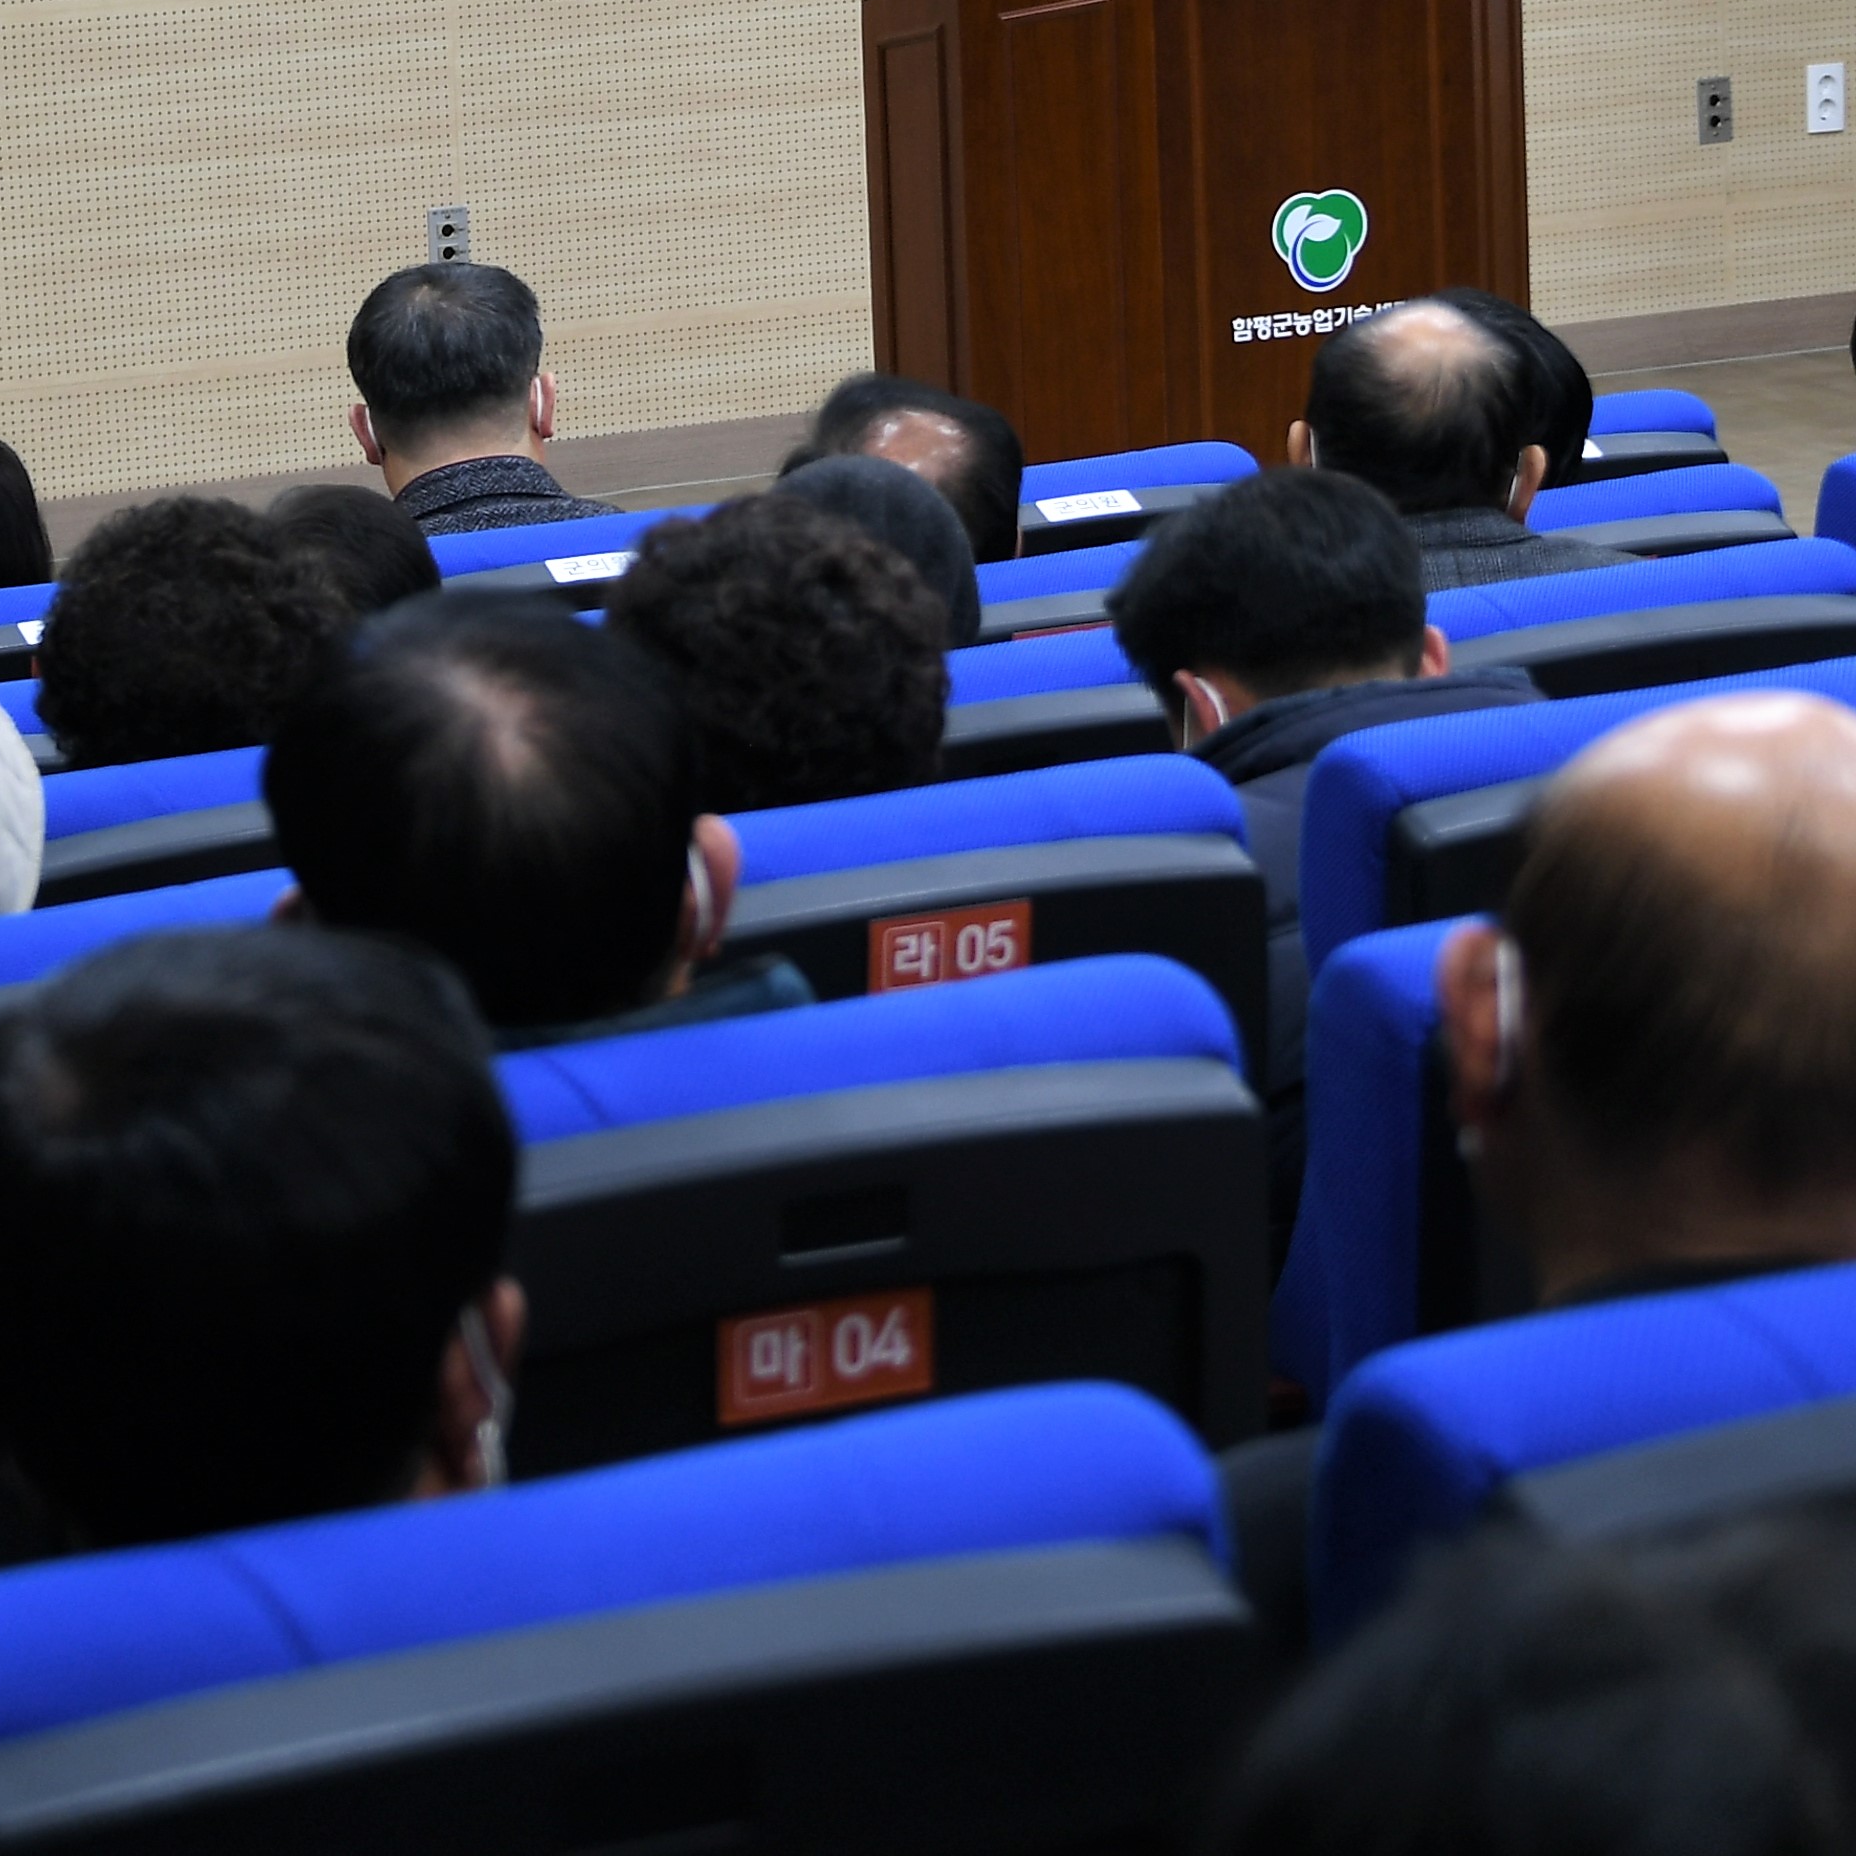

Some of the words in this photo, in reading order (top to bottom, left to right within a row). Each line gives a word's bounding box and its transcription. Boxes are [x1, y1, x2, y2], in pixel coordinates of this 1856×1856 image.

[894, 931, 936, 978] 라
[955, 918, 1017, 972] 05
[750, 1327, 805, 1385] 마
[833, 1307, 913, 1376] 04
